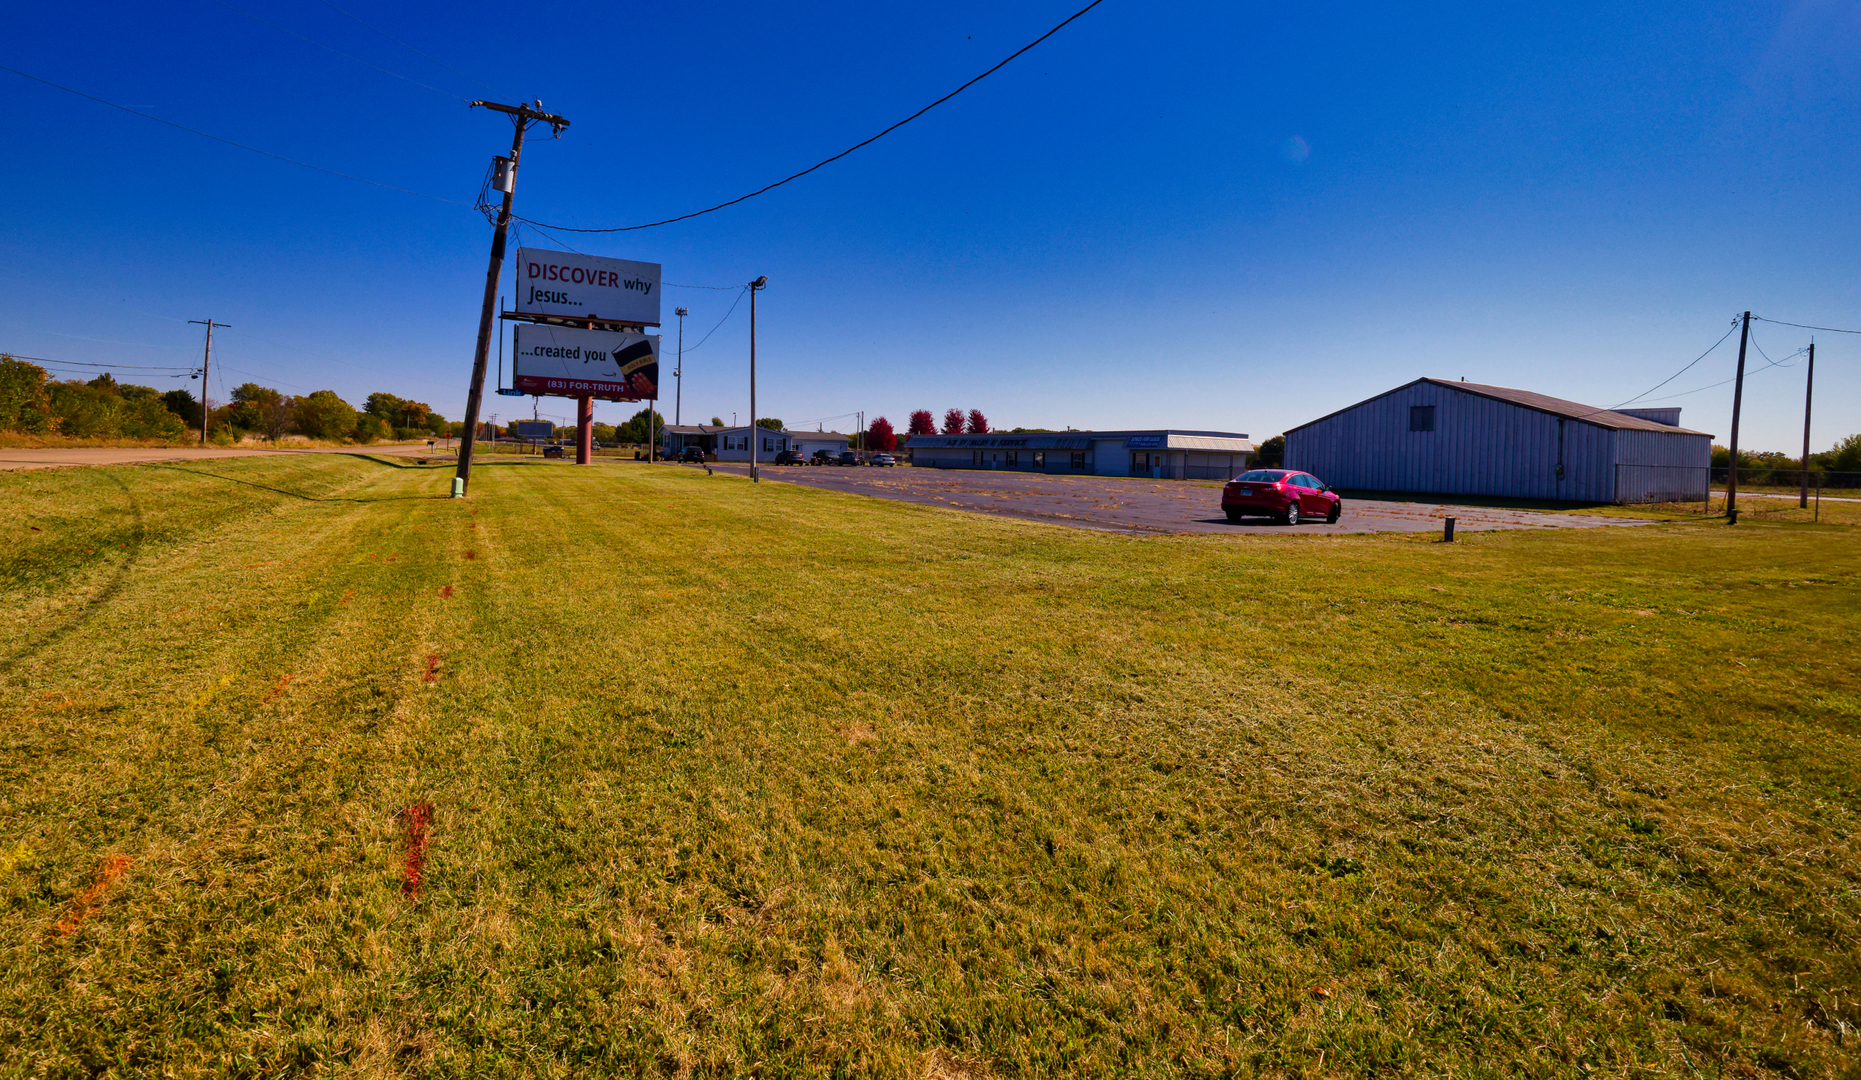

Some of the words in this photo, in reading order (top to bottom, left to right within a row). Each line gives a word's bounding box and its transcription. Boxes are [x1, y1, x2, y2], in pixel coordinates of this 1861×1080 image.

[528, 262, 619, 288] DISCOVER
[623, 278, 652, 295] why
[527, 286, 583, 306] Jesus...
[521, 346, 580, 360] ...created
[584, 350, 606, 364] you
[547, 380, 567, 389] (83)
[569, 381, 624, 393] FOR-TRUTH
